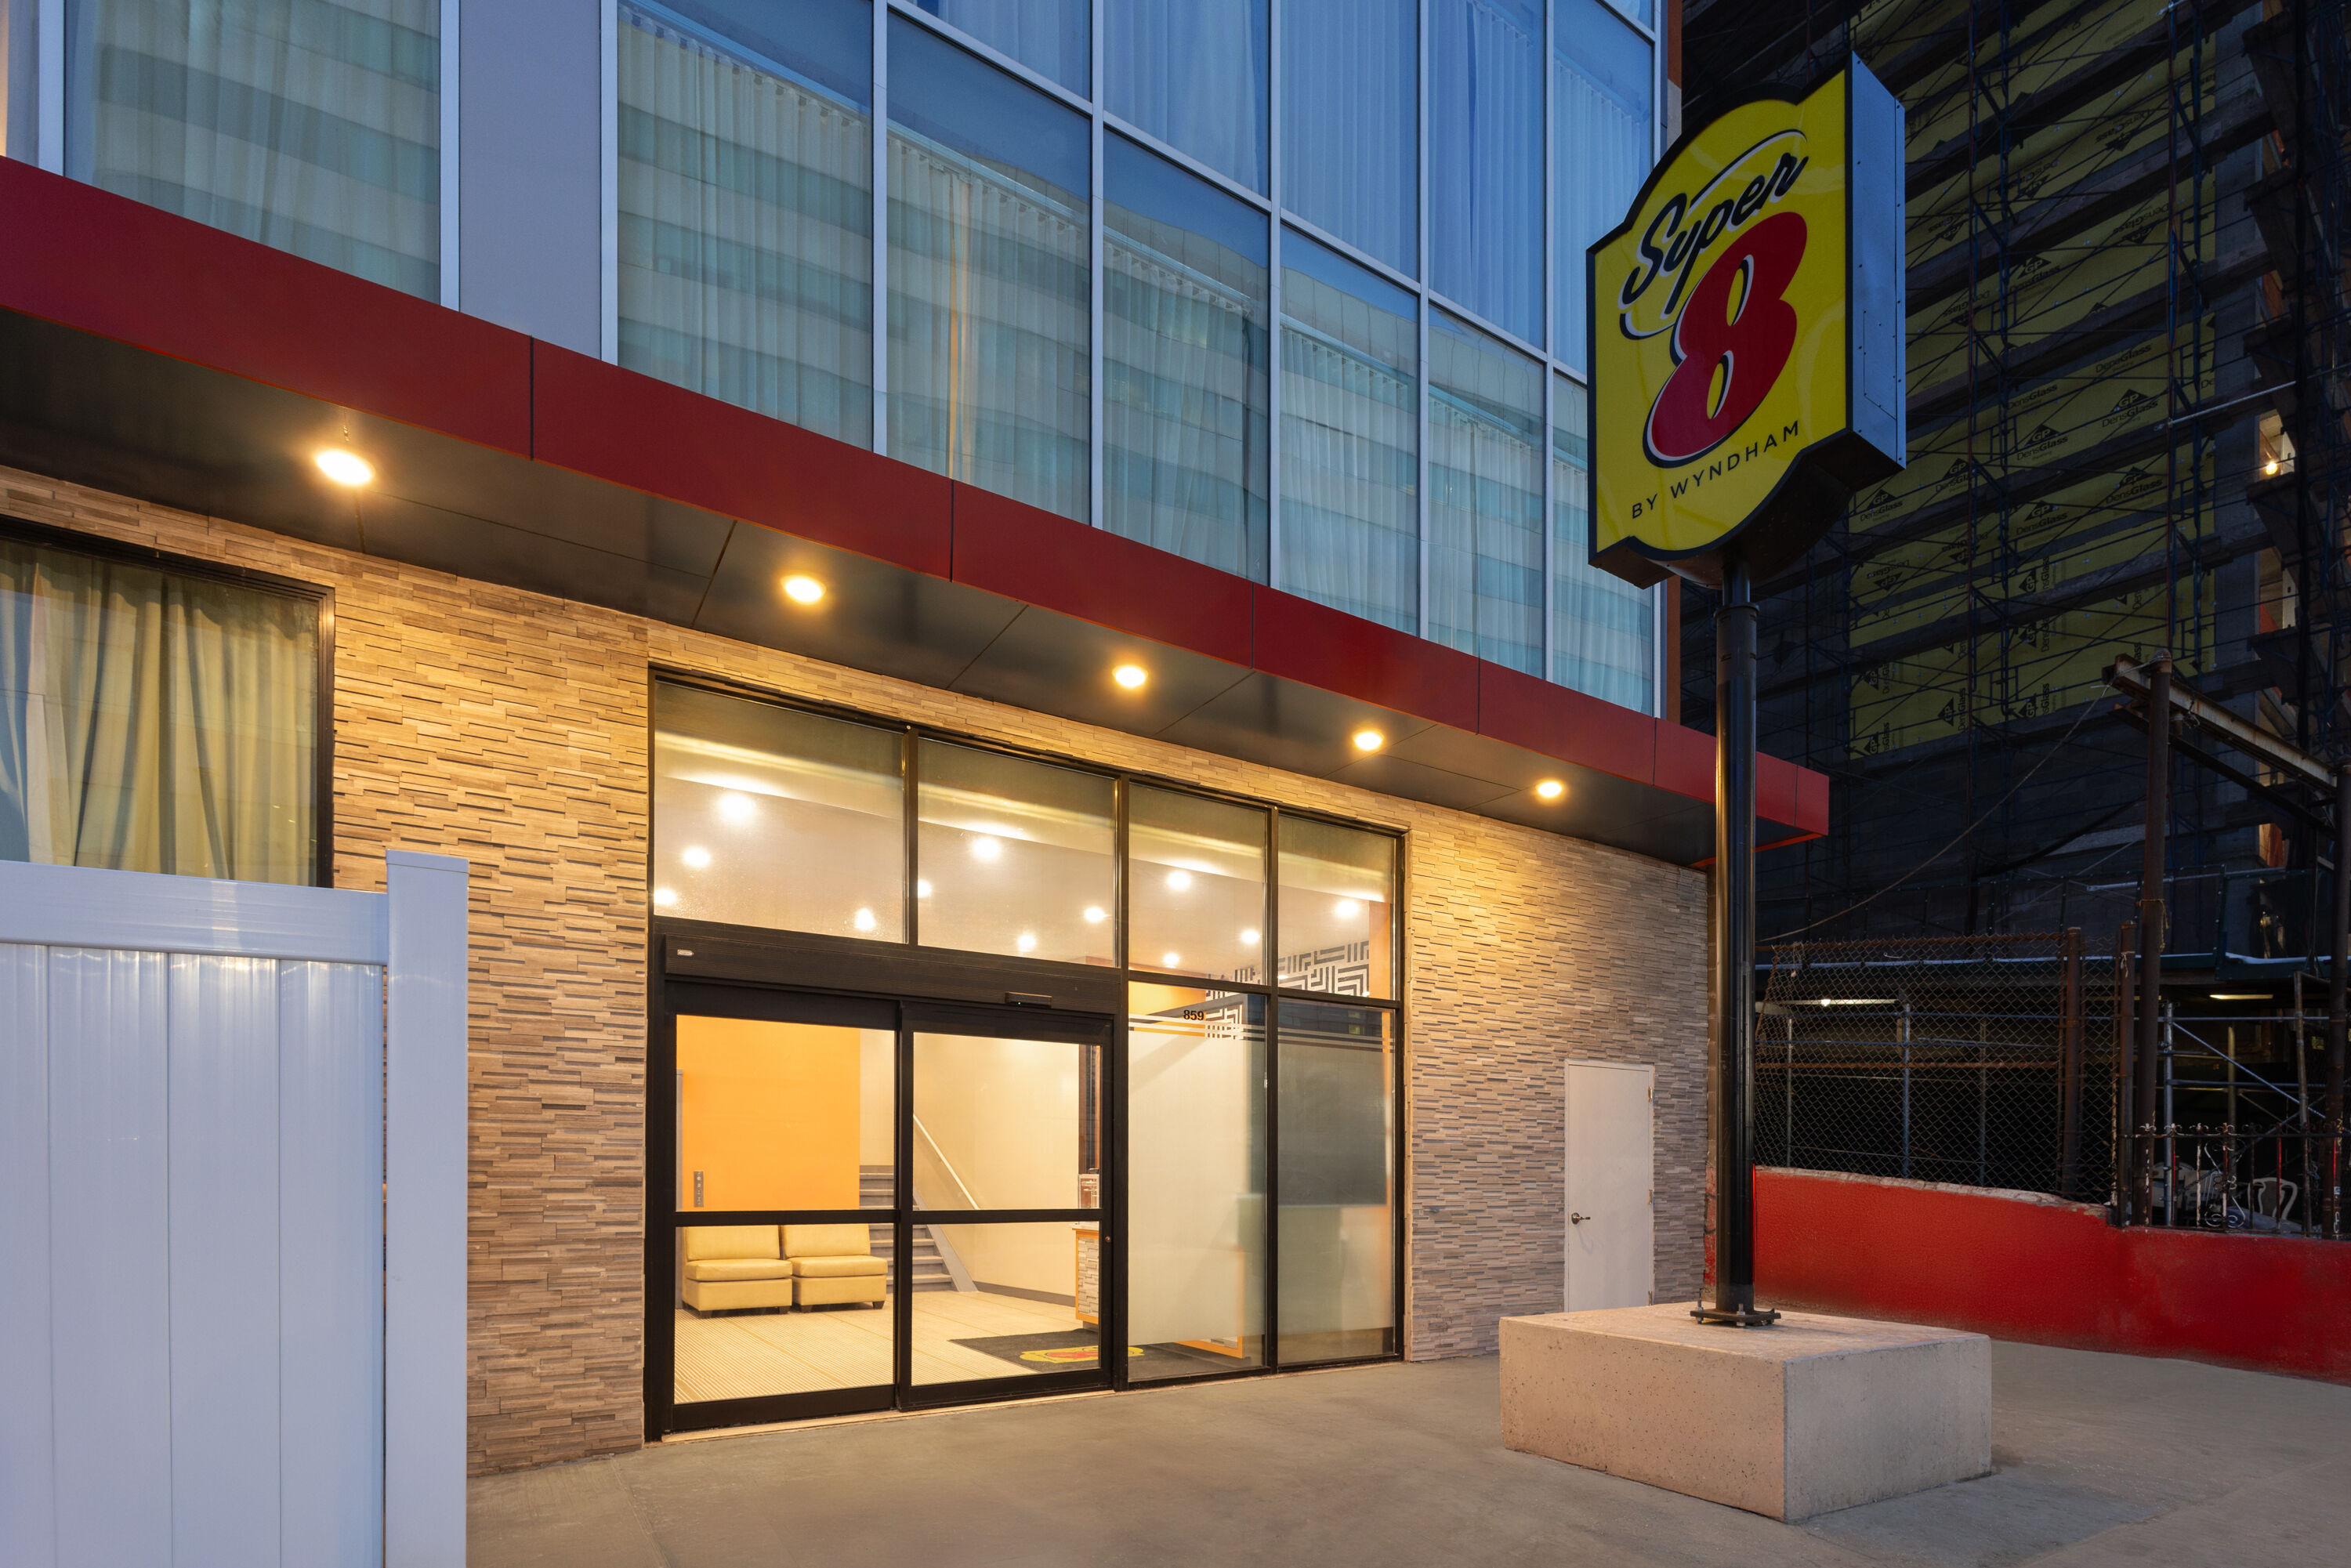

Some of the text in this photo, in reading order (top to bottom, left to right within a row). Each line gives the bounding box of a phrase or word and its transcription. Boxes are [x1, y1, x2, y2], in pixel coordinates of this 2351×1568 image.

[1619, 151, 1809, 318] Super
[2025, 261, 2043, 274] GP
[1643, 212, 1808, 469] 8
[2119, 393, 2139, 407] GP
[2102, 399, 2158, 427] DensGlass
[2017, 436, 2068, 461] DensGlass
[1632, 420, 1799, 519] BY WYNDHAM
[1949, 462, 1967, 475] GP
[1872, 494, 1889, 505] GP
[2106, 479, 2162, 504] DensGlass
[1860, 502, 1904, 522] DensGlass
[2016, 512, 2068, 535] DensGlass
[2027, 576, 2035, 592] GP
[1945, 704, 1952, 722] GP
[2026, 702, 2035, 718] GP
[1871, 739, 1878, 755] GP
[1183, 1009, 1204, 1021] 859
